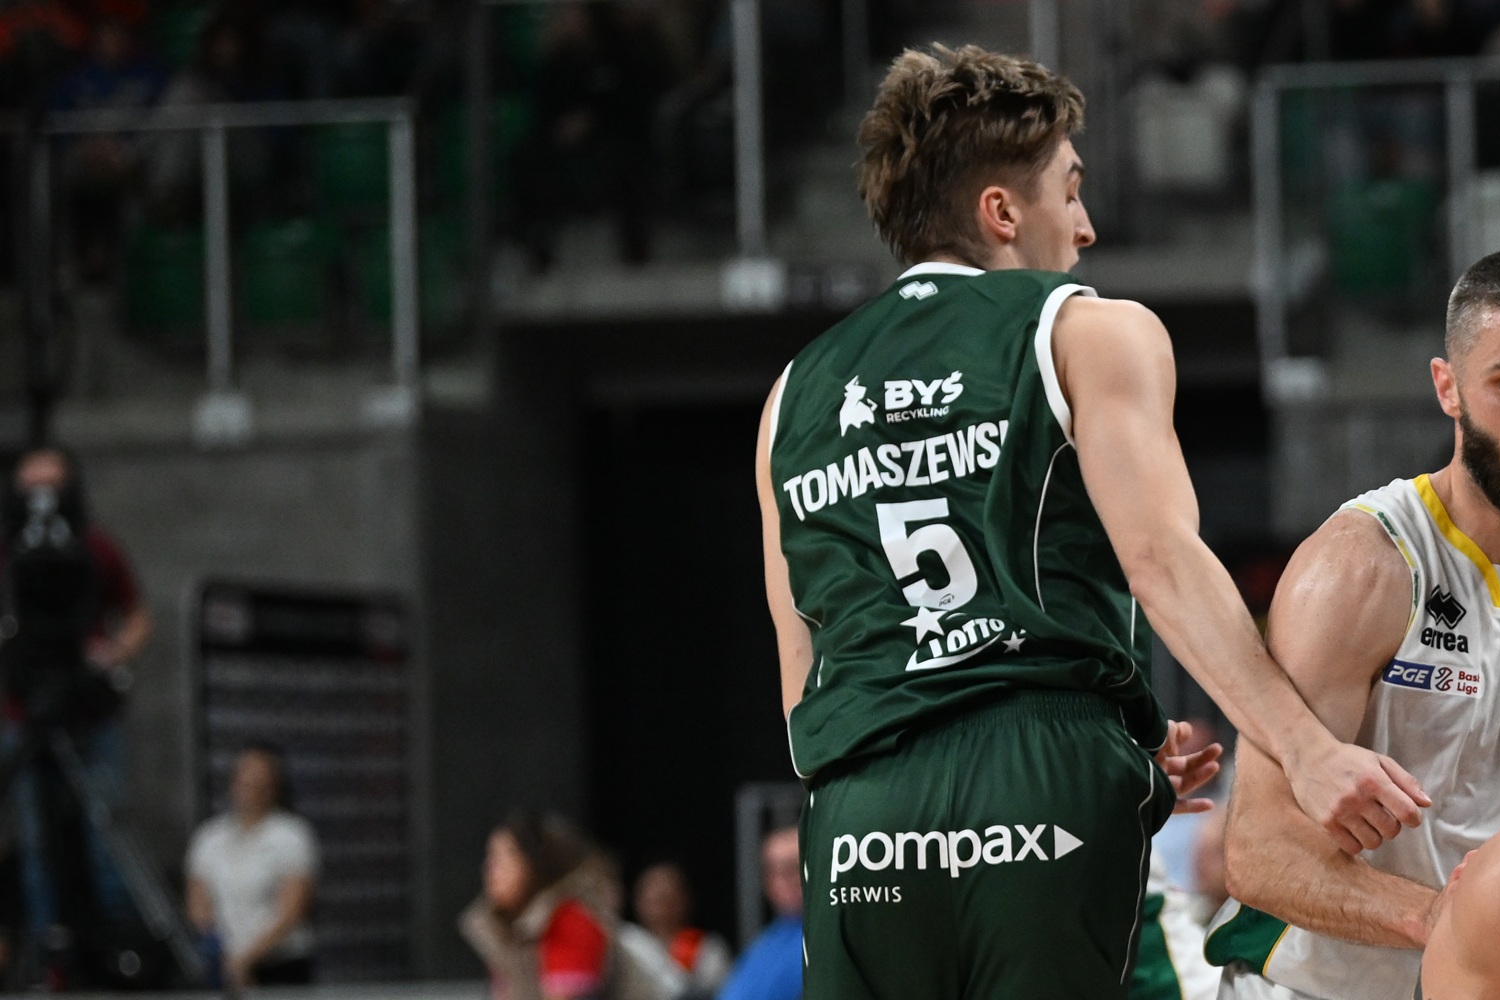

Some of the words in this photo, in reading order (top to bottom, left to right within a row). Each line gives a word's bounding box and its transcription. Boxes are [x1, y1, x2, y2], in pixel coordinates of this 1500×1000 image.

[886, 405, 949, 423] RECYKLING
[875, 497, 978, 611] 5
[1388, 664, 1429, 684] PGE
[830, 823, 1049, 883] pompax
[829, 886, 902, 906] SERWIS
